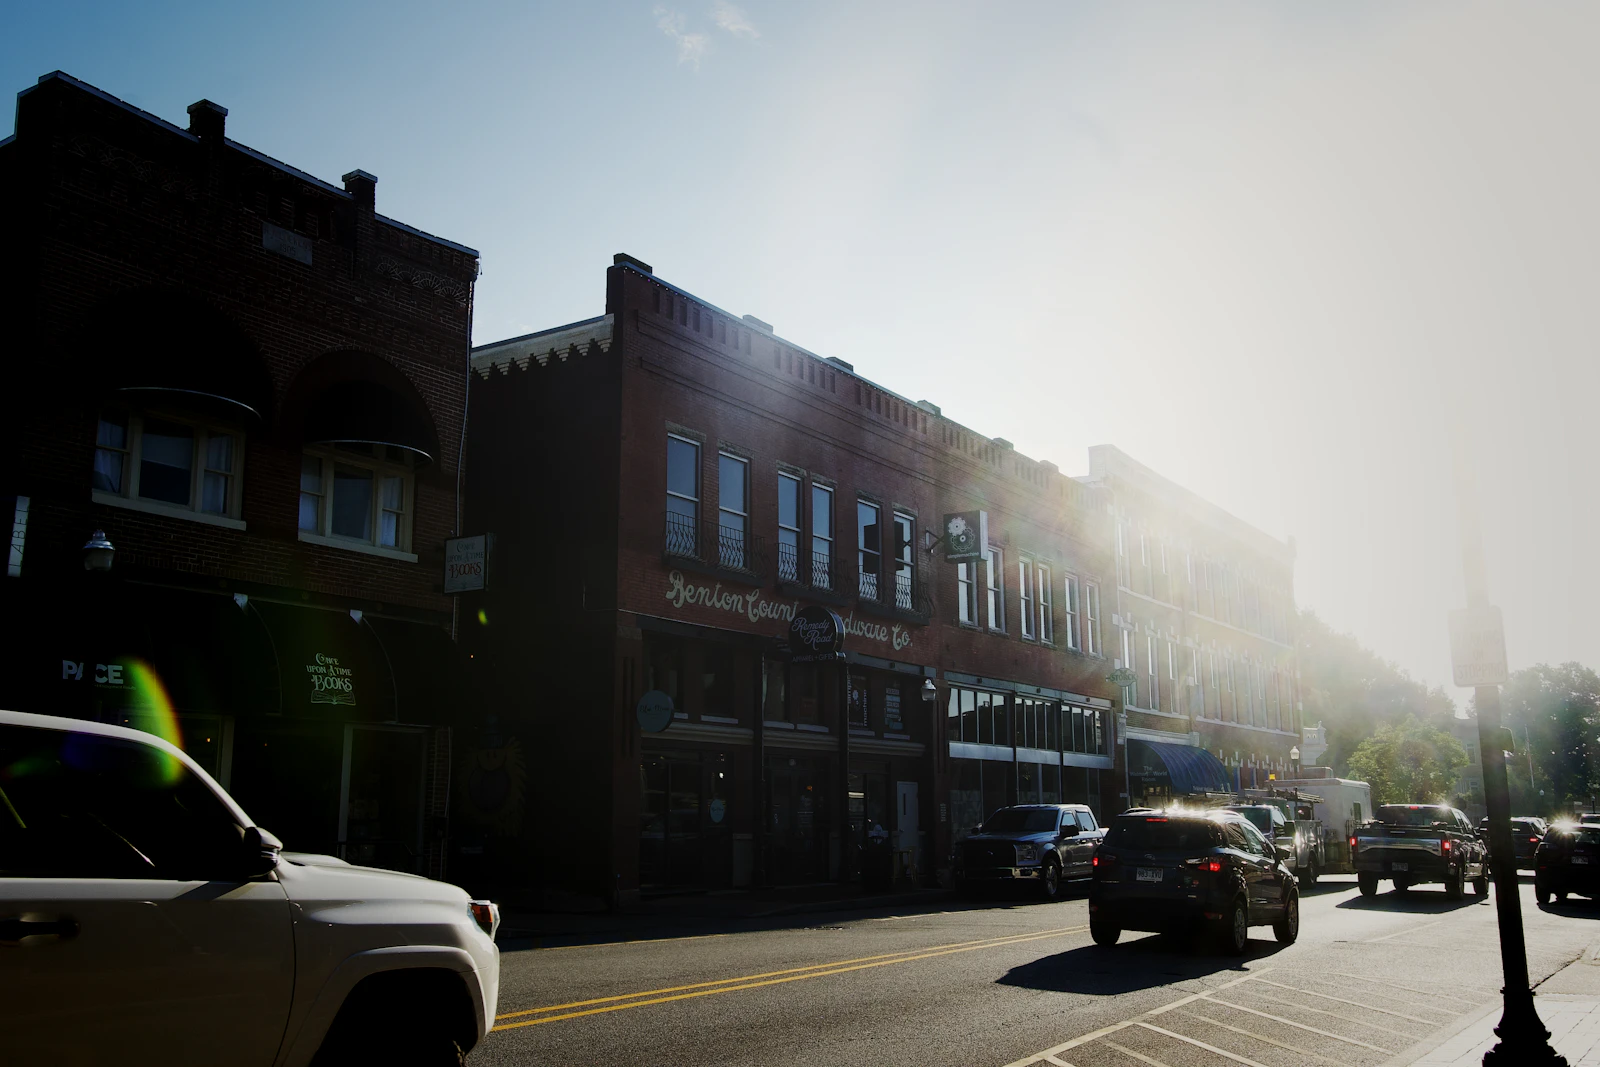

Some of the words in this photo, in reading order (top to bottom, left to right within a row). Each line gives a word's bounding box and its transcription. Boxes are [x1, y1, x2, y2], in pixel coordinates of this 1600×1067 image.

[449, 561, 482, 579] BOOKS
[665, 570, 744, 609] Benton
[745, 589, 800, 623] Count
[791, 616, 830, 639] Remedy
[803, 629, 834, 651] Road
[310, 674, 353, 693] BOOKS
